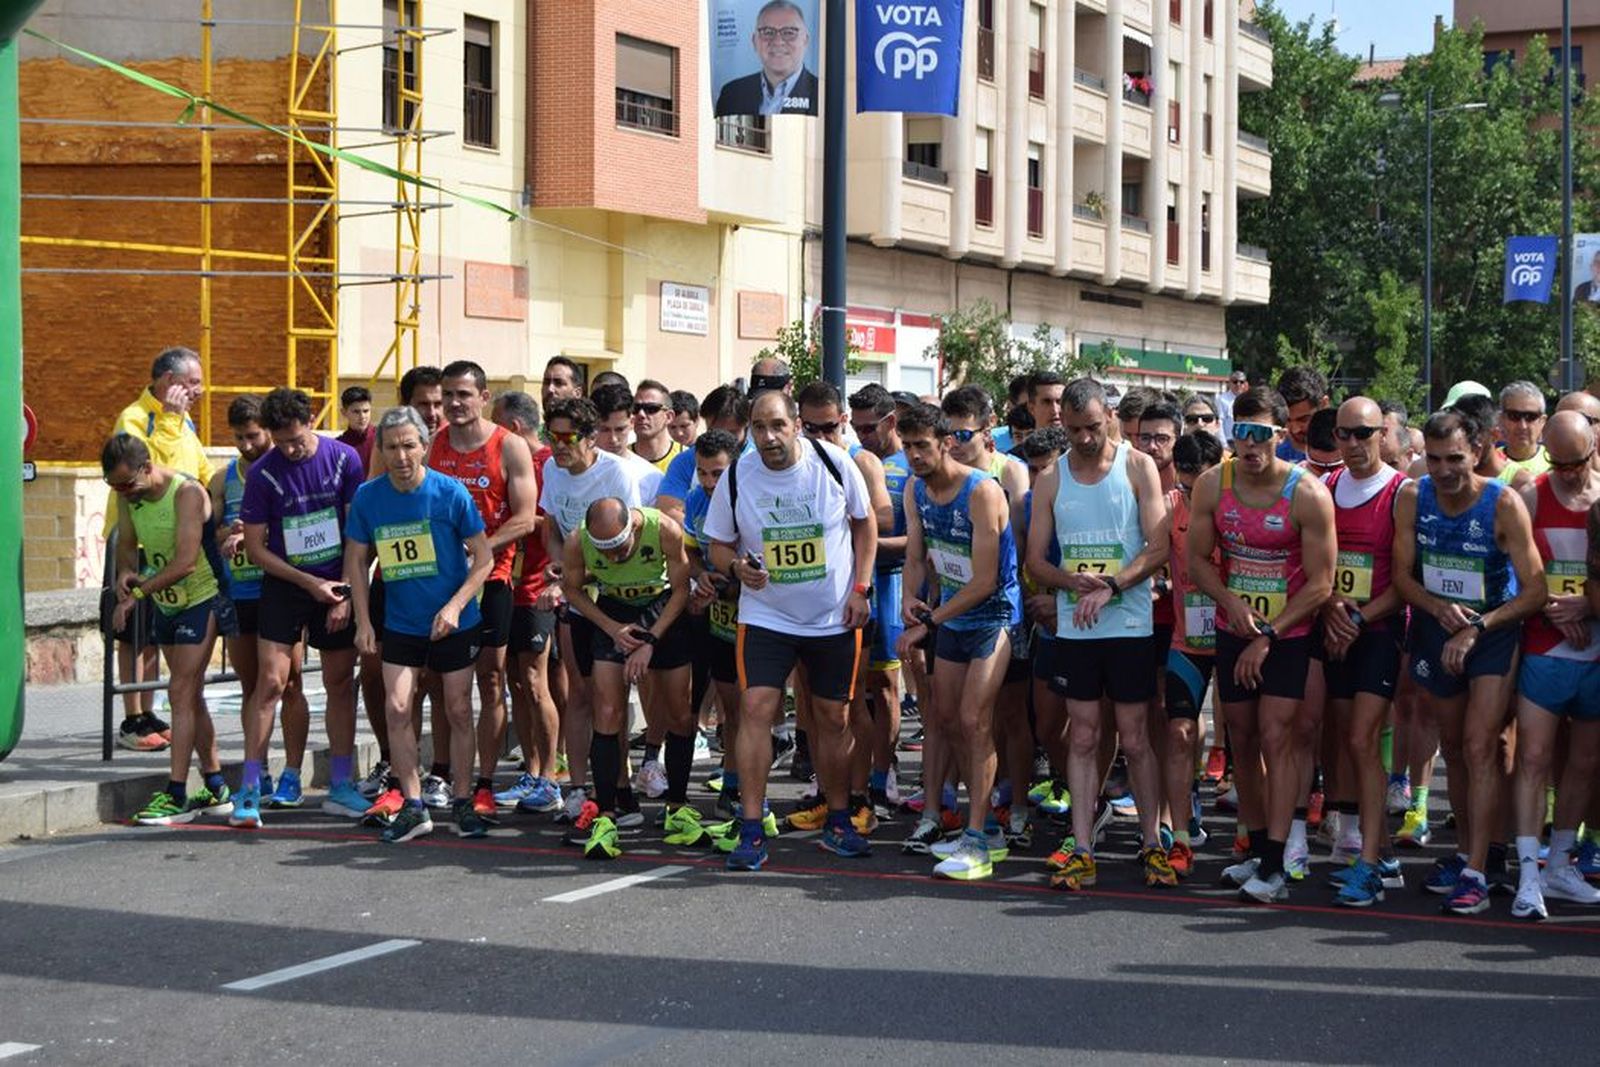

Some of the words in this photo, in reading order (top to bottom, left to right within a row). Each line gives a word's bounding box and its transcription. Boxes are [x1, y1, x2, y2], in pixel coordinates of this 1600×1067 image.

[876, 5, 943, 26] VOTA
[783, 97, 809, 109] 28M
[1514, 252, 1545, 263] VOTA
[391, 539, 418, 563] 18
[770, 541, 816, 568] 150
